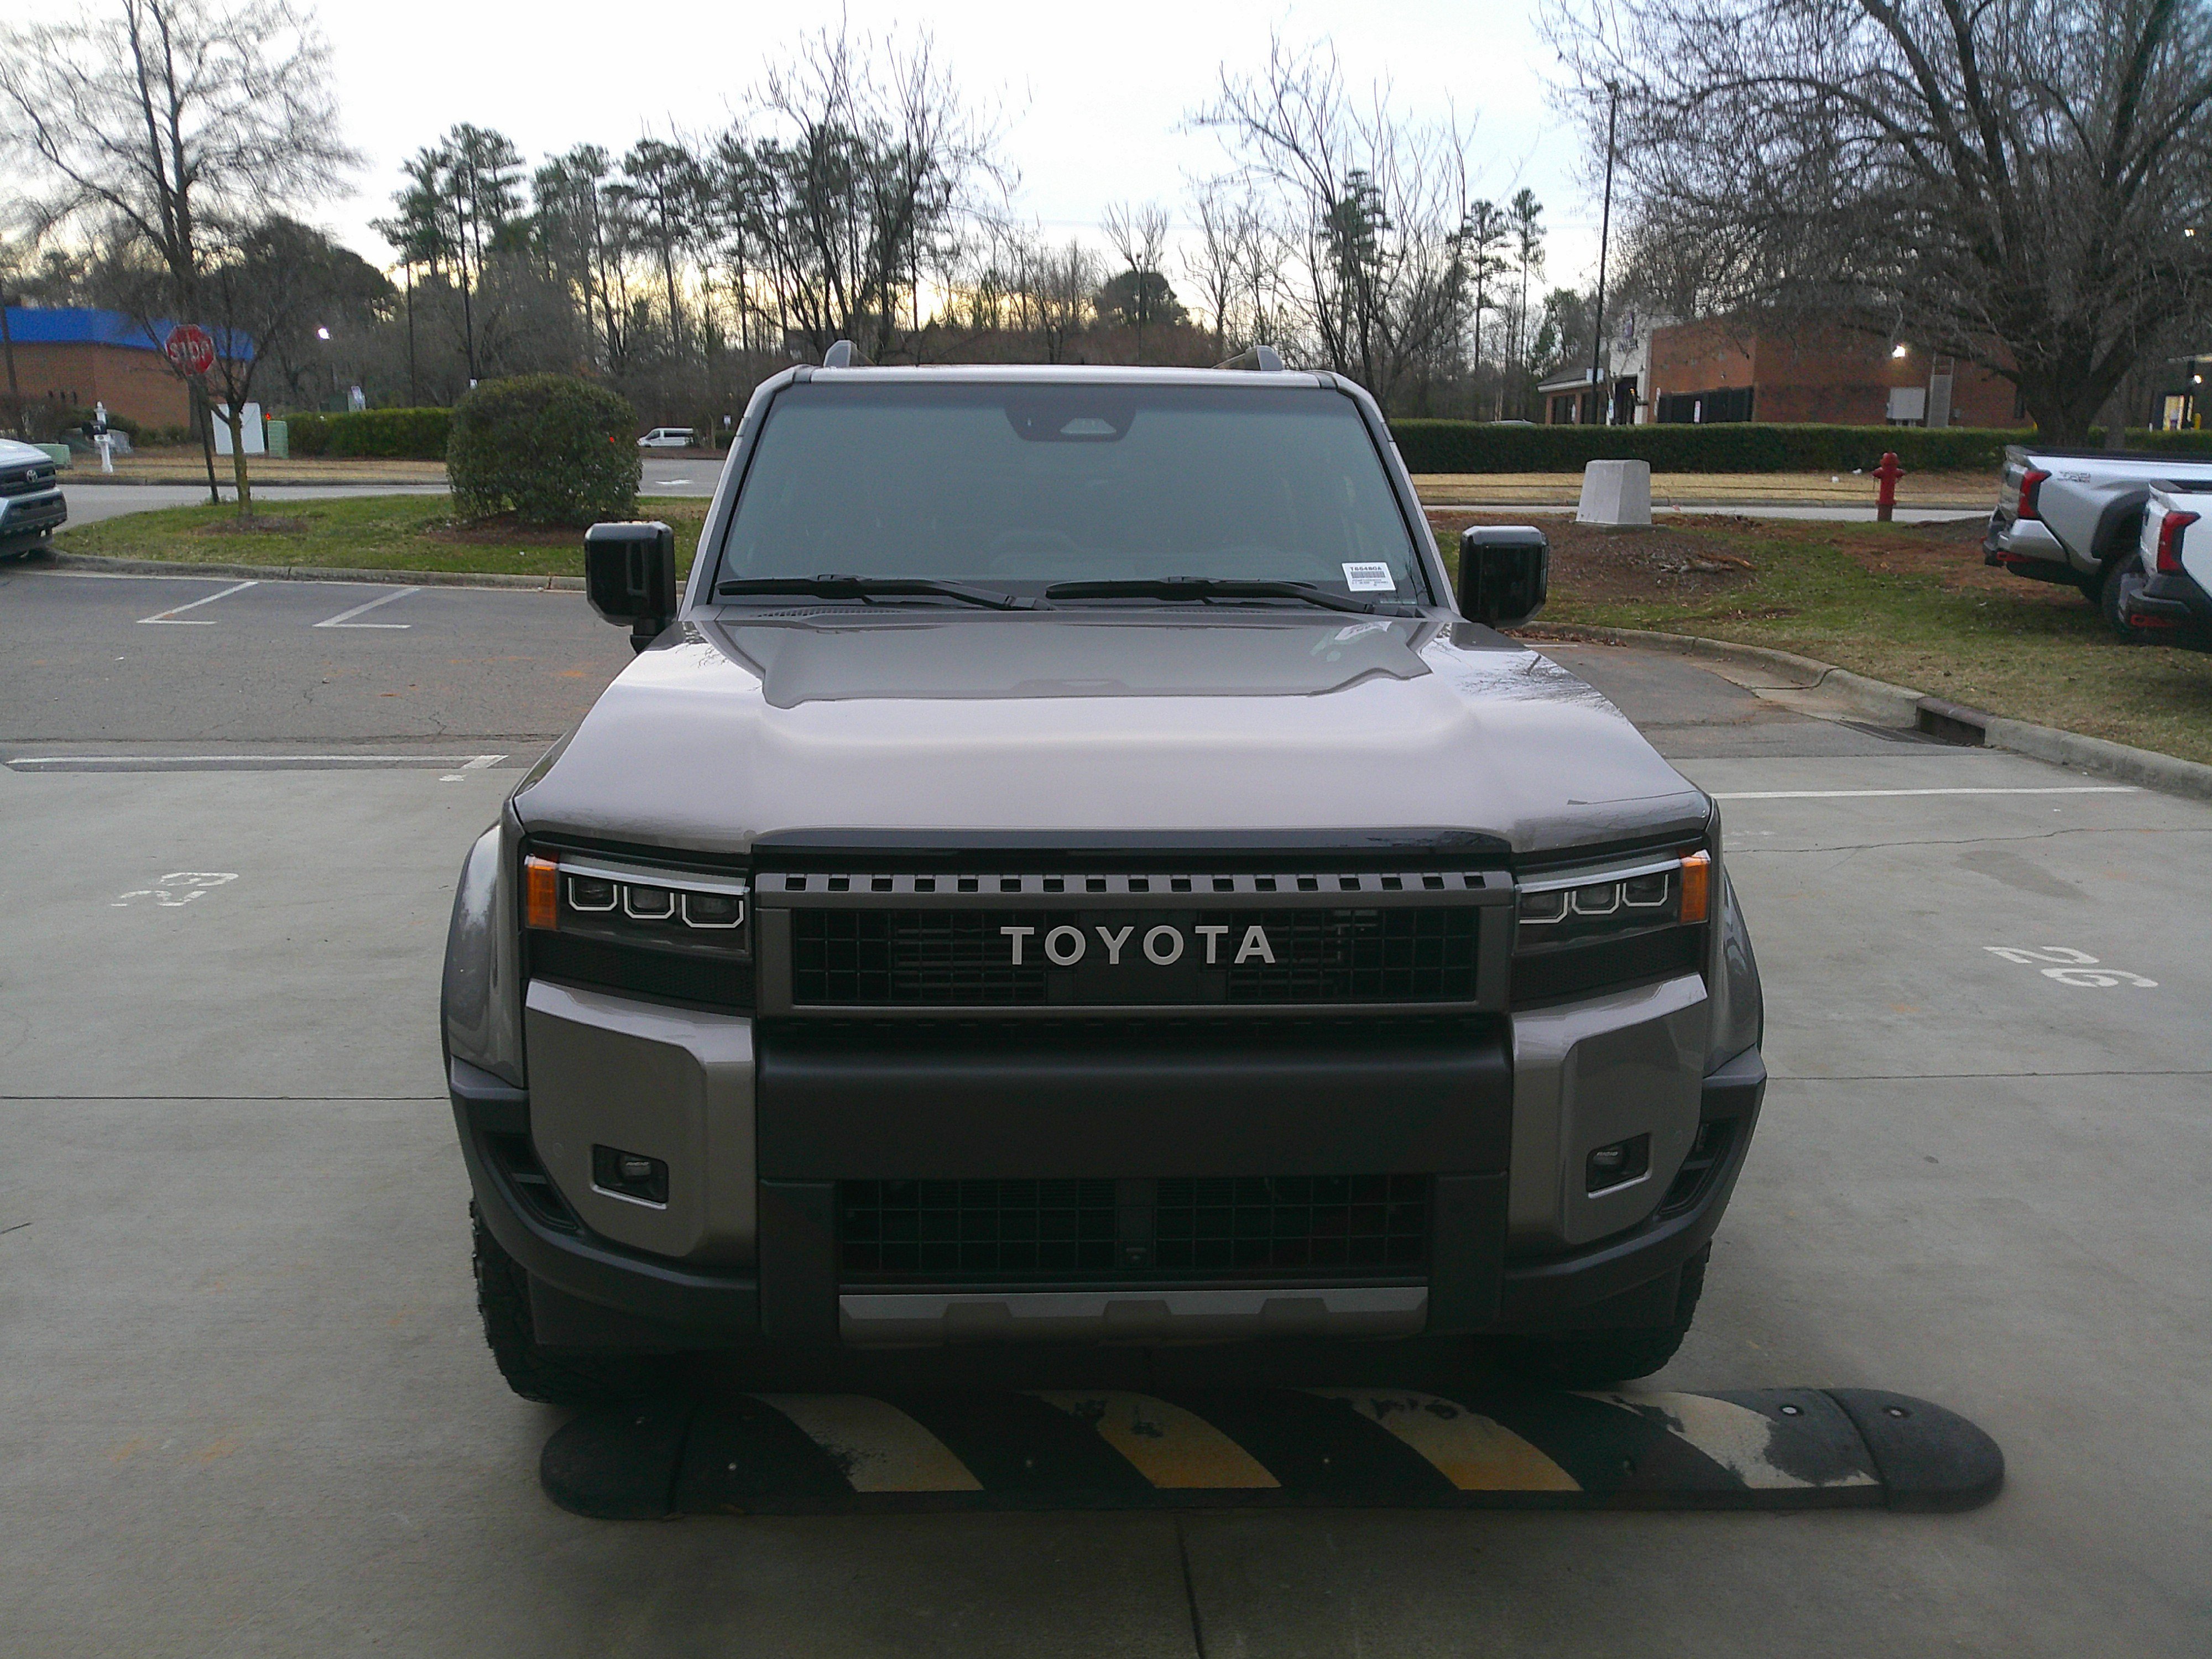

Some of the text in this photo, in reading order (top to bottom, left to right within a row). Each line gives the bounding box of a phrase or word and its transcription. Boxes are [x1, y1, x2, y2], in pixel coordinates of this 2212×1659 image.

[169, 341, 210, 362] STOP
[1000, 925, 1276, 966] TOYOTA
[1982, 946, 2158, 988] 26
